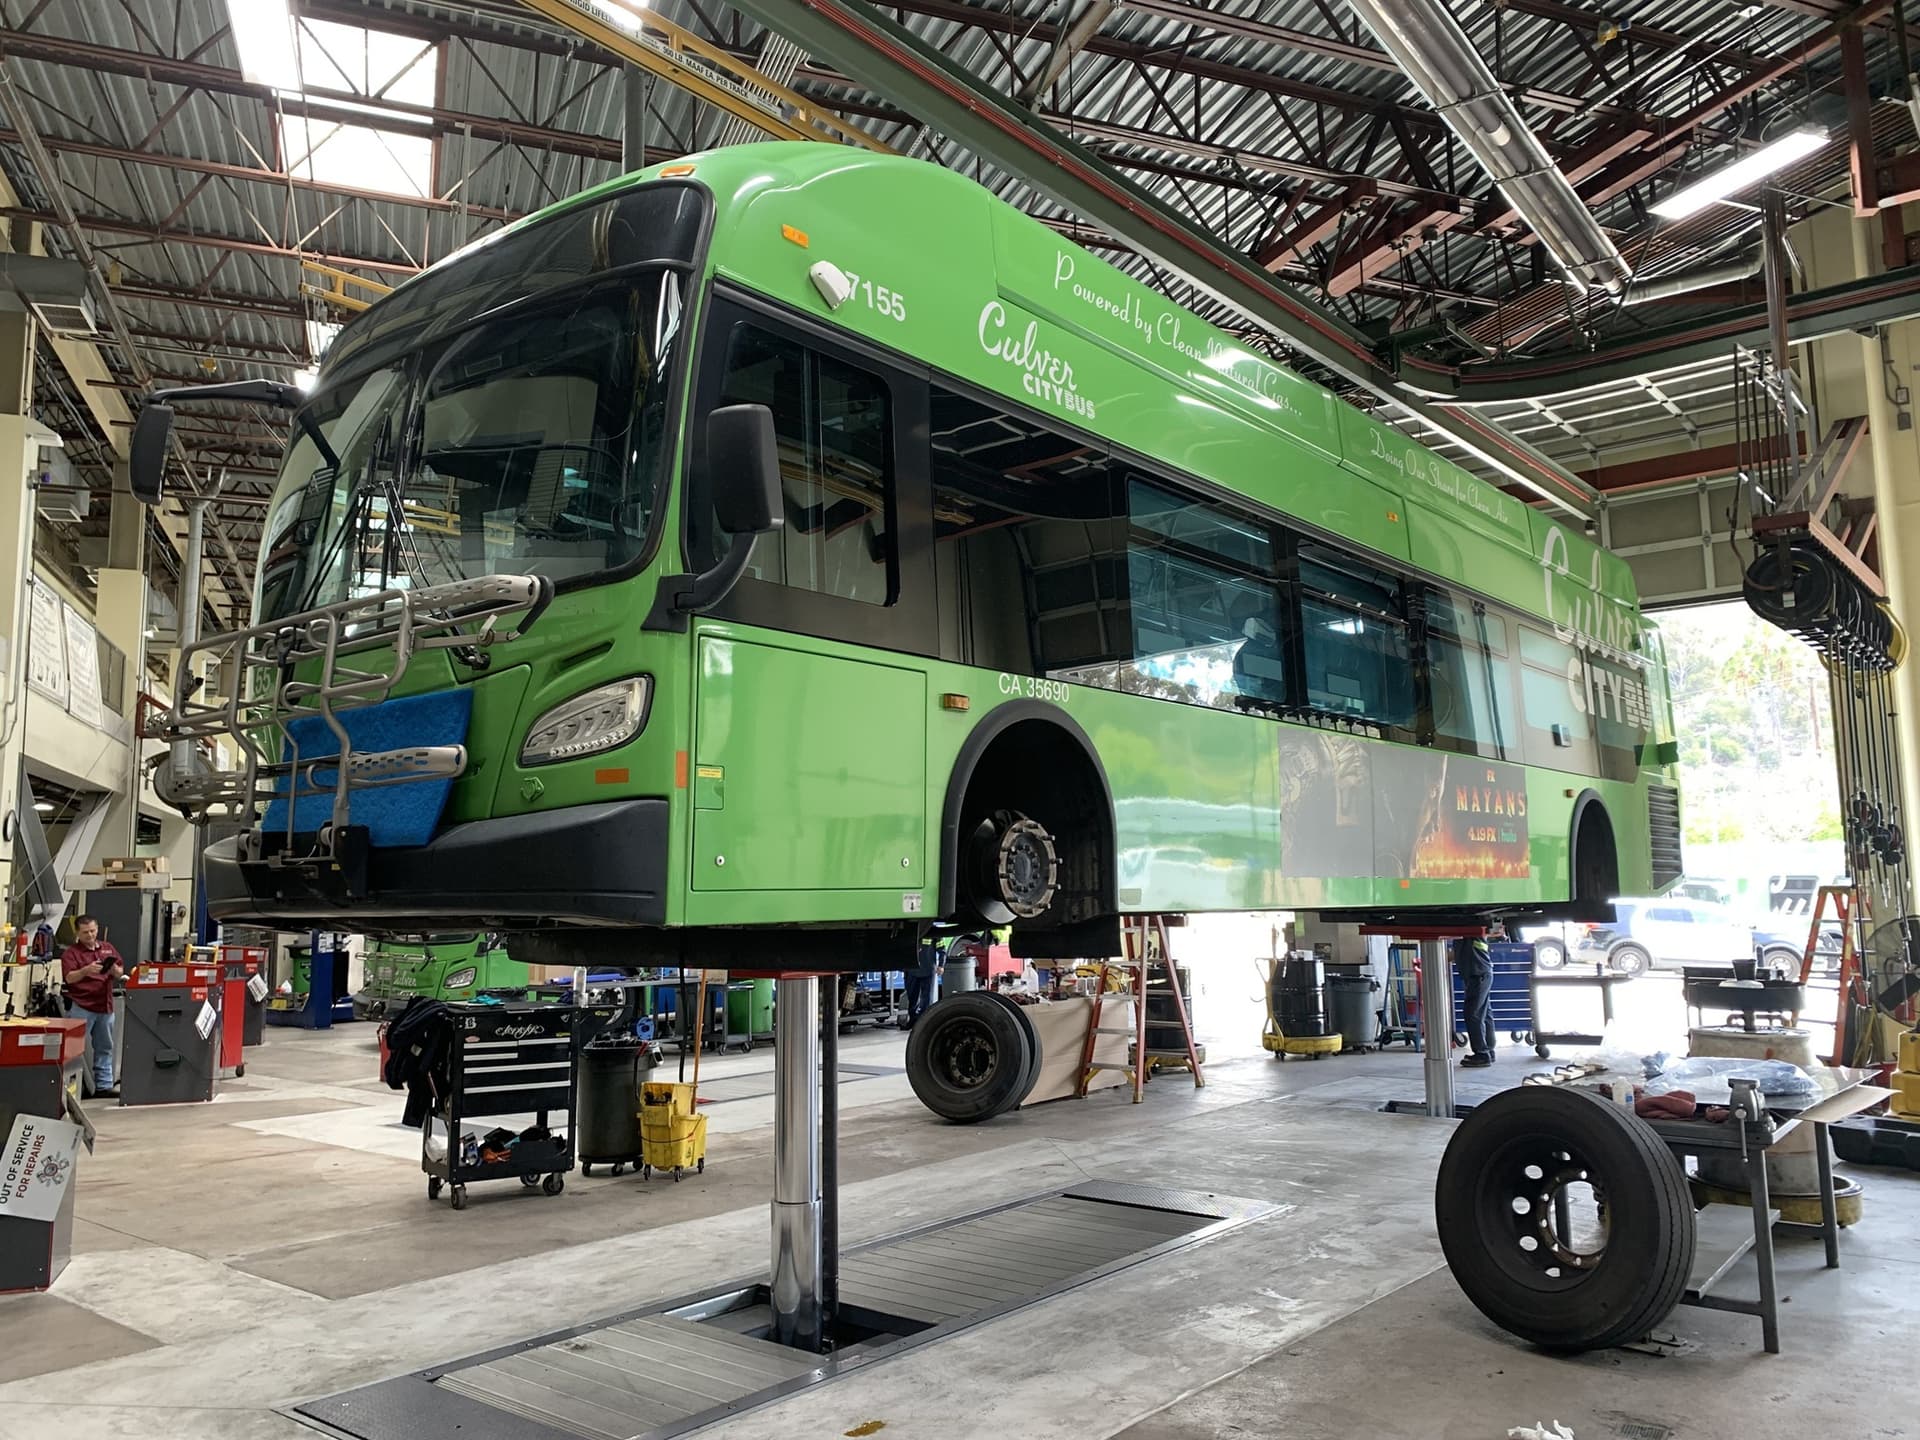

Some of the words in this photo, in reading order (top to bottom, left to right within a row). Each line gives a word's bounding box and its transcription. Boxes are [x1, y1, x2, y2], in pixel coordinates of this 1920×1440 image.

[716, 75, 729, 89] PER
[729, 82, 748, 98] TRACK
[844, 271, 906, 322] 7155
[1054, 250, 1130, 324] Powered
[1134, 298, 1152, 344] by
[1156, 312, 1202, 361] Clean
[978, 300, 1077, 392] Culver
[1370, 427, 1404, 476] Doing
[999, 672, 1022, 695] CA
[1026, 677, 1070, 703] 35690
[1456, 785, 1526, 817] MAYANS
[0, 1182, 12, 1205] OUT
[7, 1167, 18, 1181] OF
[13, 1124, 34, 1166] SERVICE
[16, 1179, 30, 1199] FOR
[24, 1134, 46, 1176] REPAIRS
